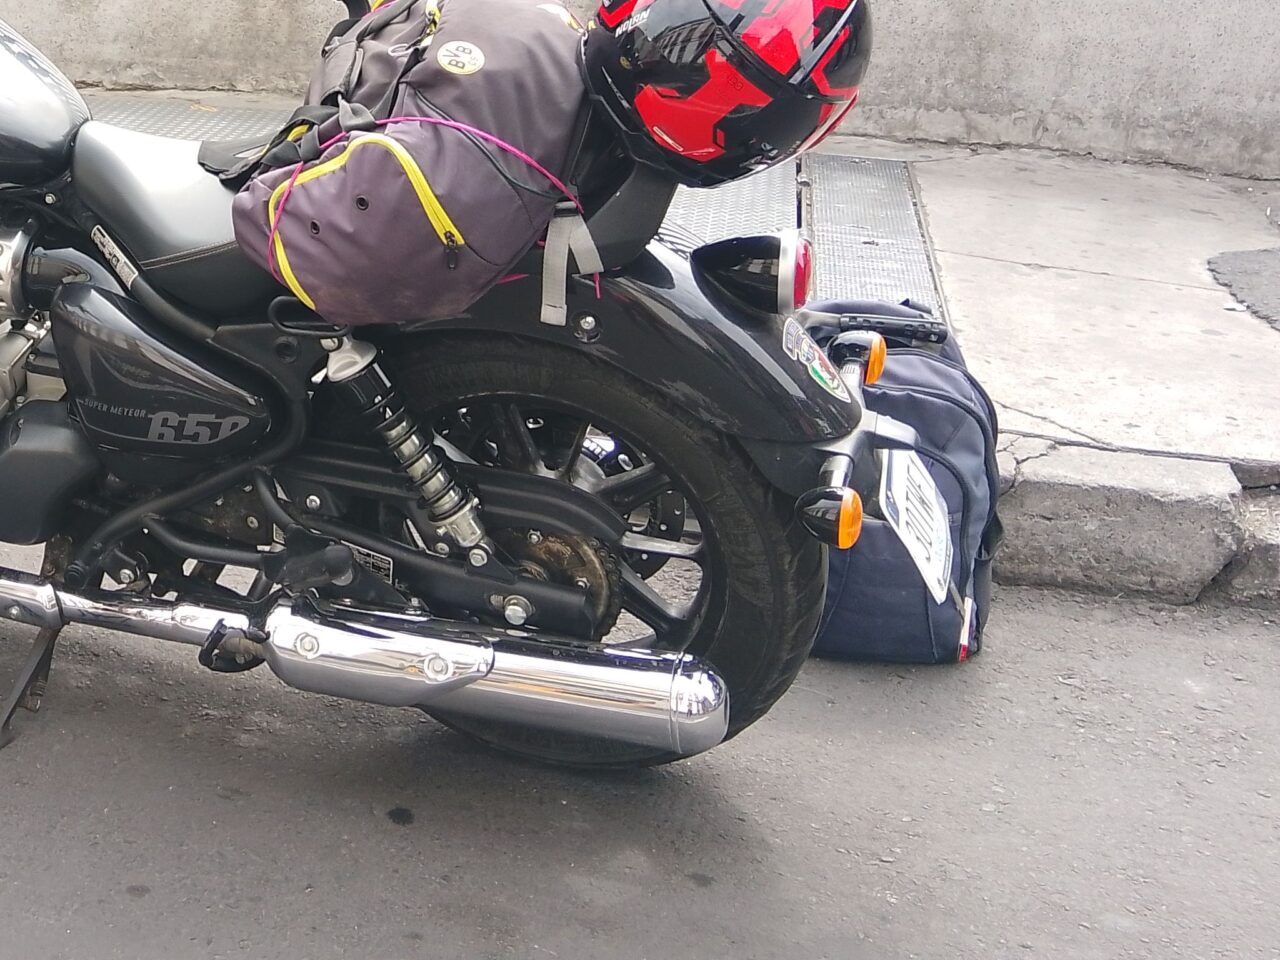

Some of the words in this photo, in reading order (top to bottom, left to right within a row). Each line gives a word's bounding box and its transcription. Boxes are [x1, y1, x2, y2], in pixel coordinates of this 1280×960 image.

[615, 8, 651, 38] NOLAN
[84, 398, 108, 412] SUPER
[110, 405, 147, 418] METEOR
